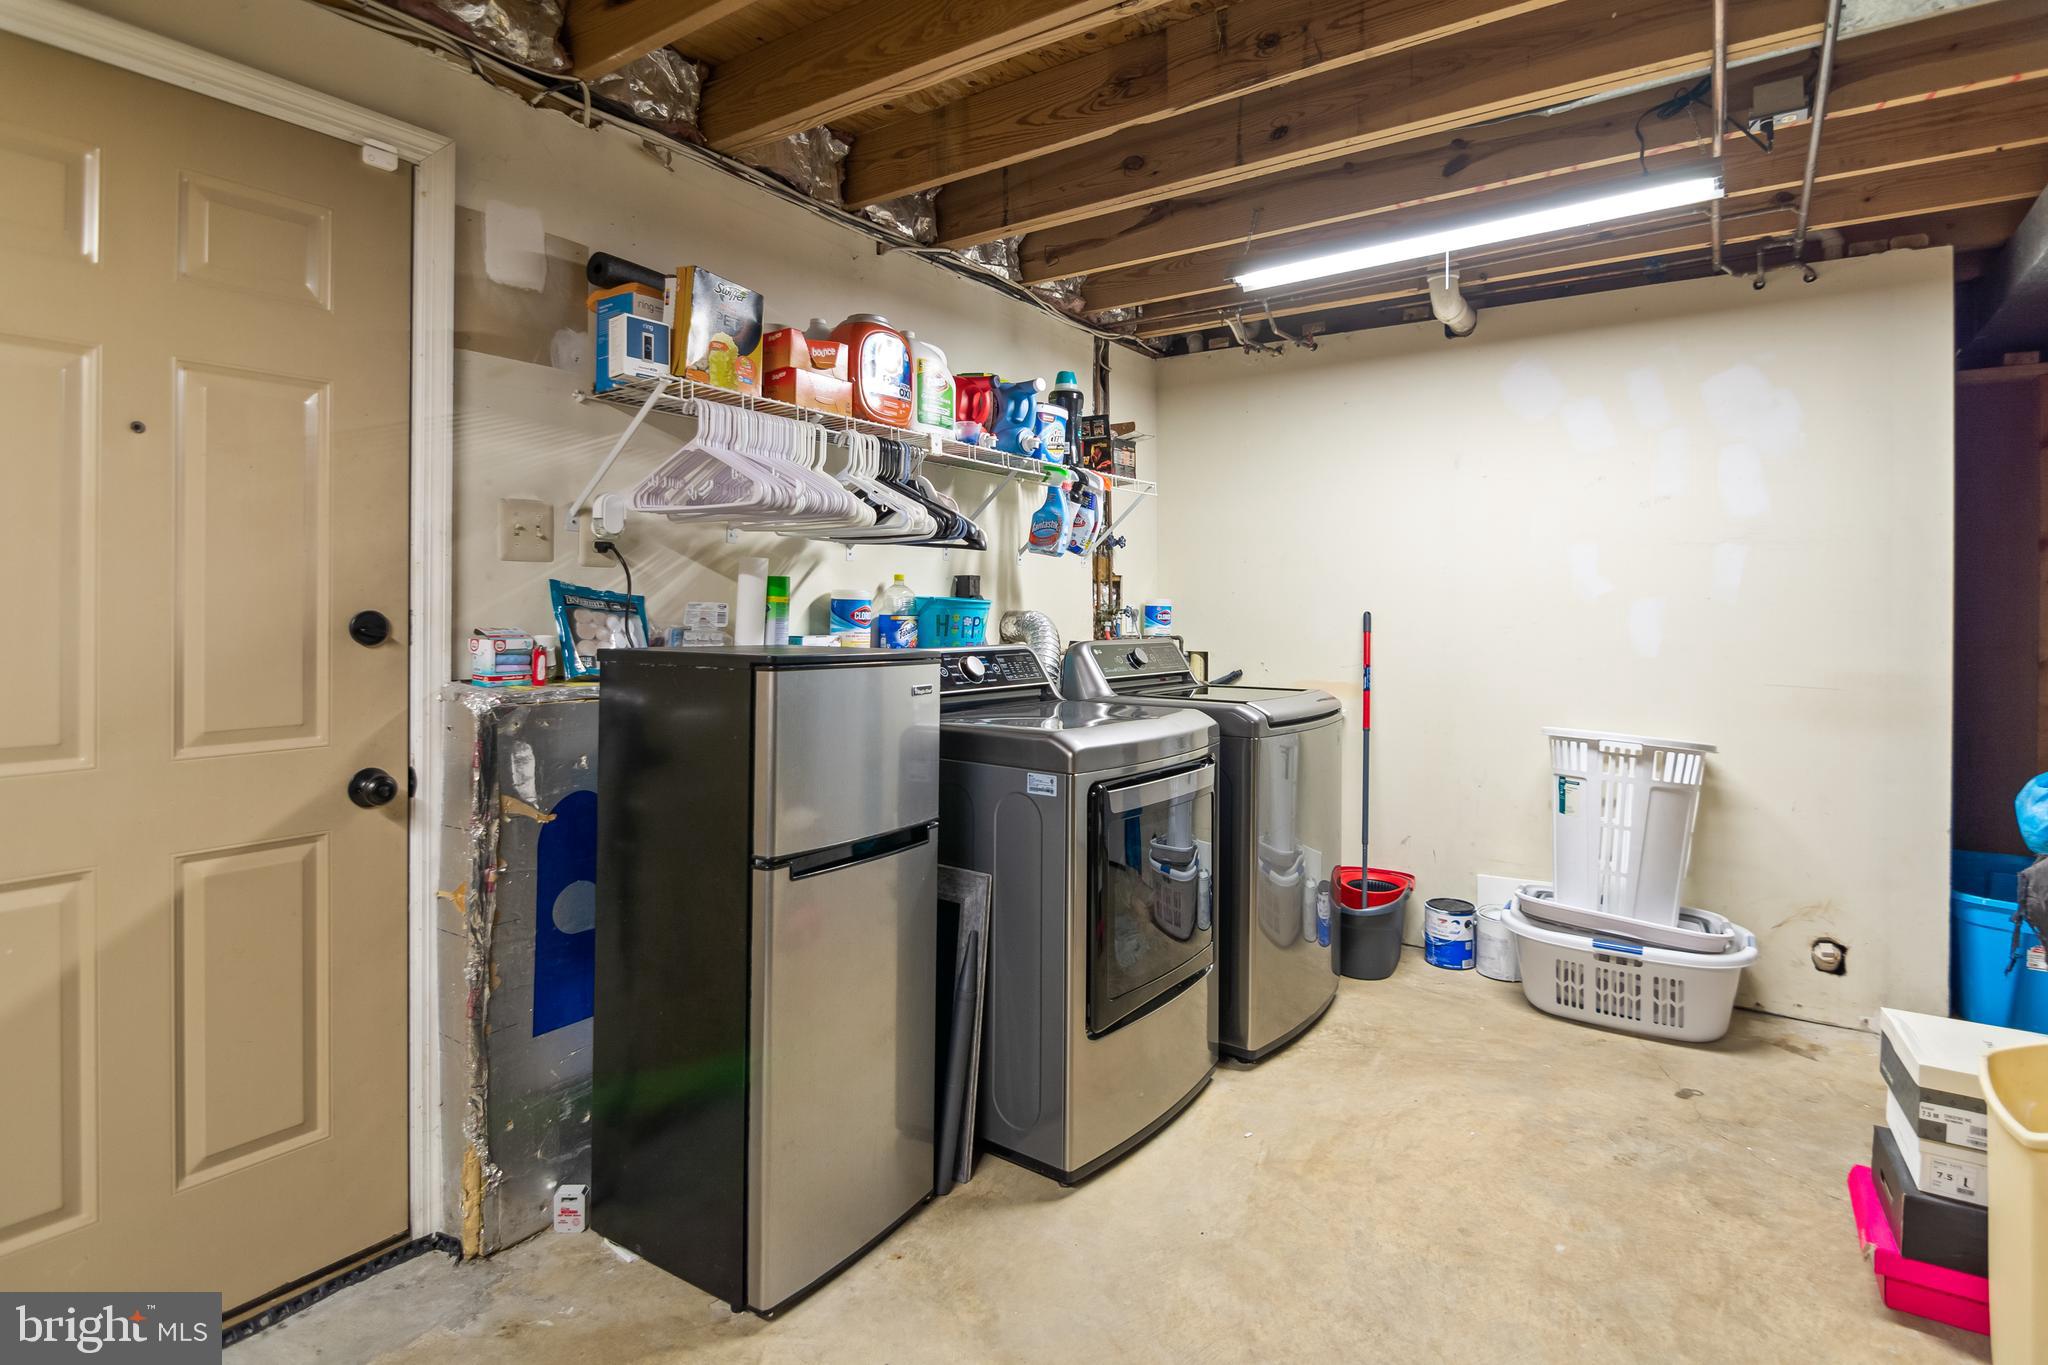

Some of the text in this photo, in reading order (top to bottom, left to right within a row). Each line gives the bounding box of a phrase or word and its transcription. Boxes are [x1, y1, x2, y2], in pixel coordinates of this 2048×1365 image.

[714, 282, 747, 302] Swiffer
[638, 301, 655, 313] ring
[642, 323, 654, 331] ring
[811, 347, 836, 357] bounce
[899, 388, 911, 399] OXI
[1936, 1171, 1953, 1181] 7.5
